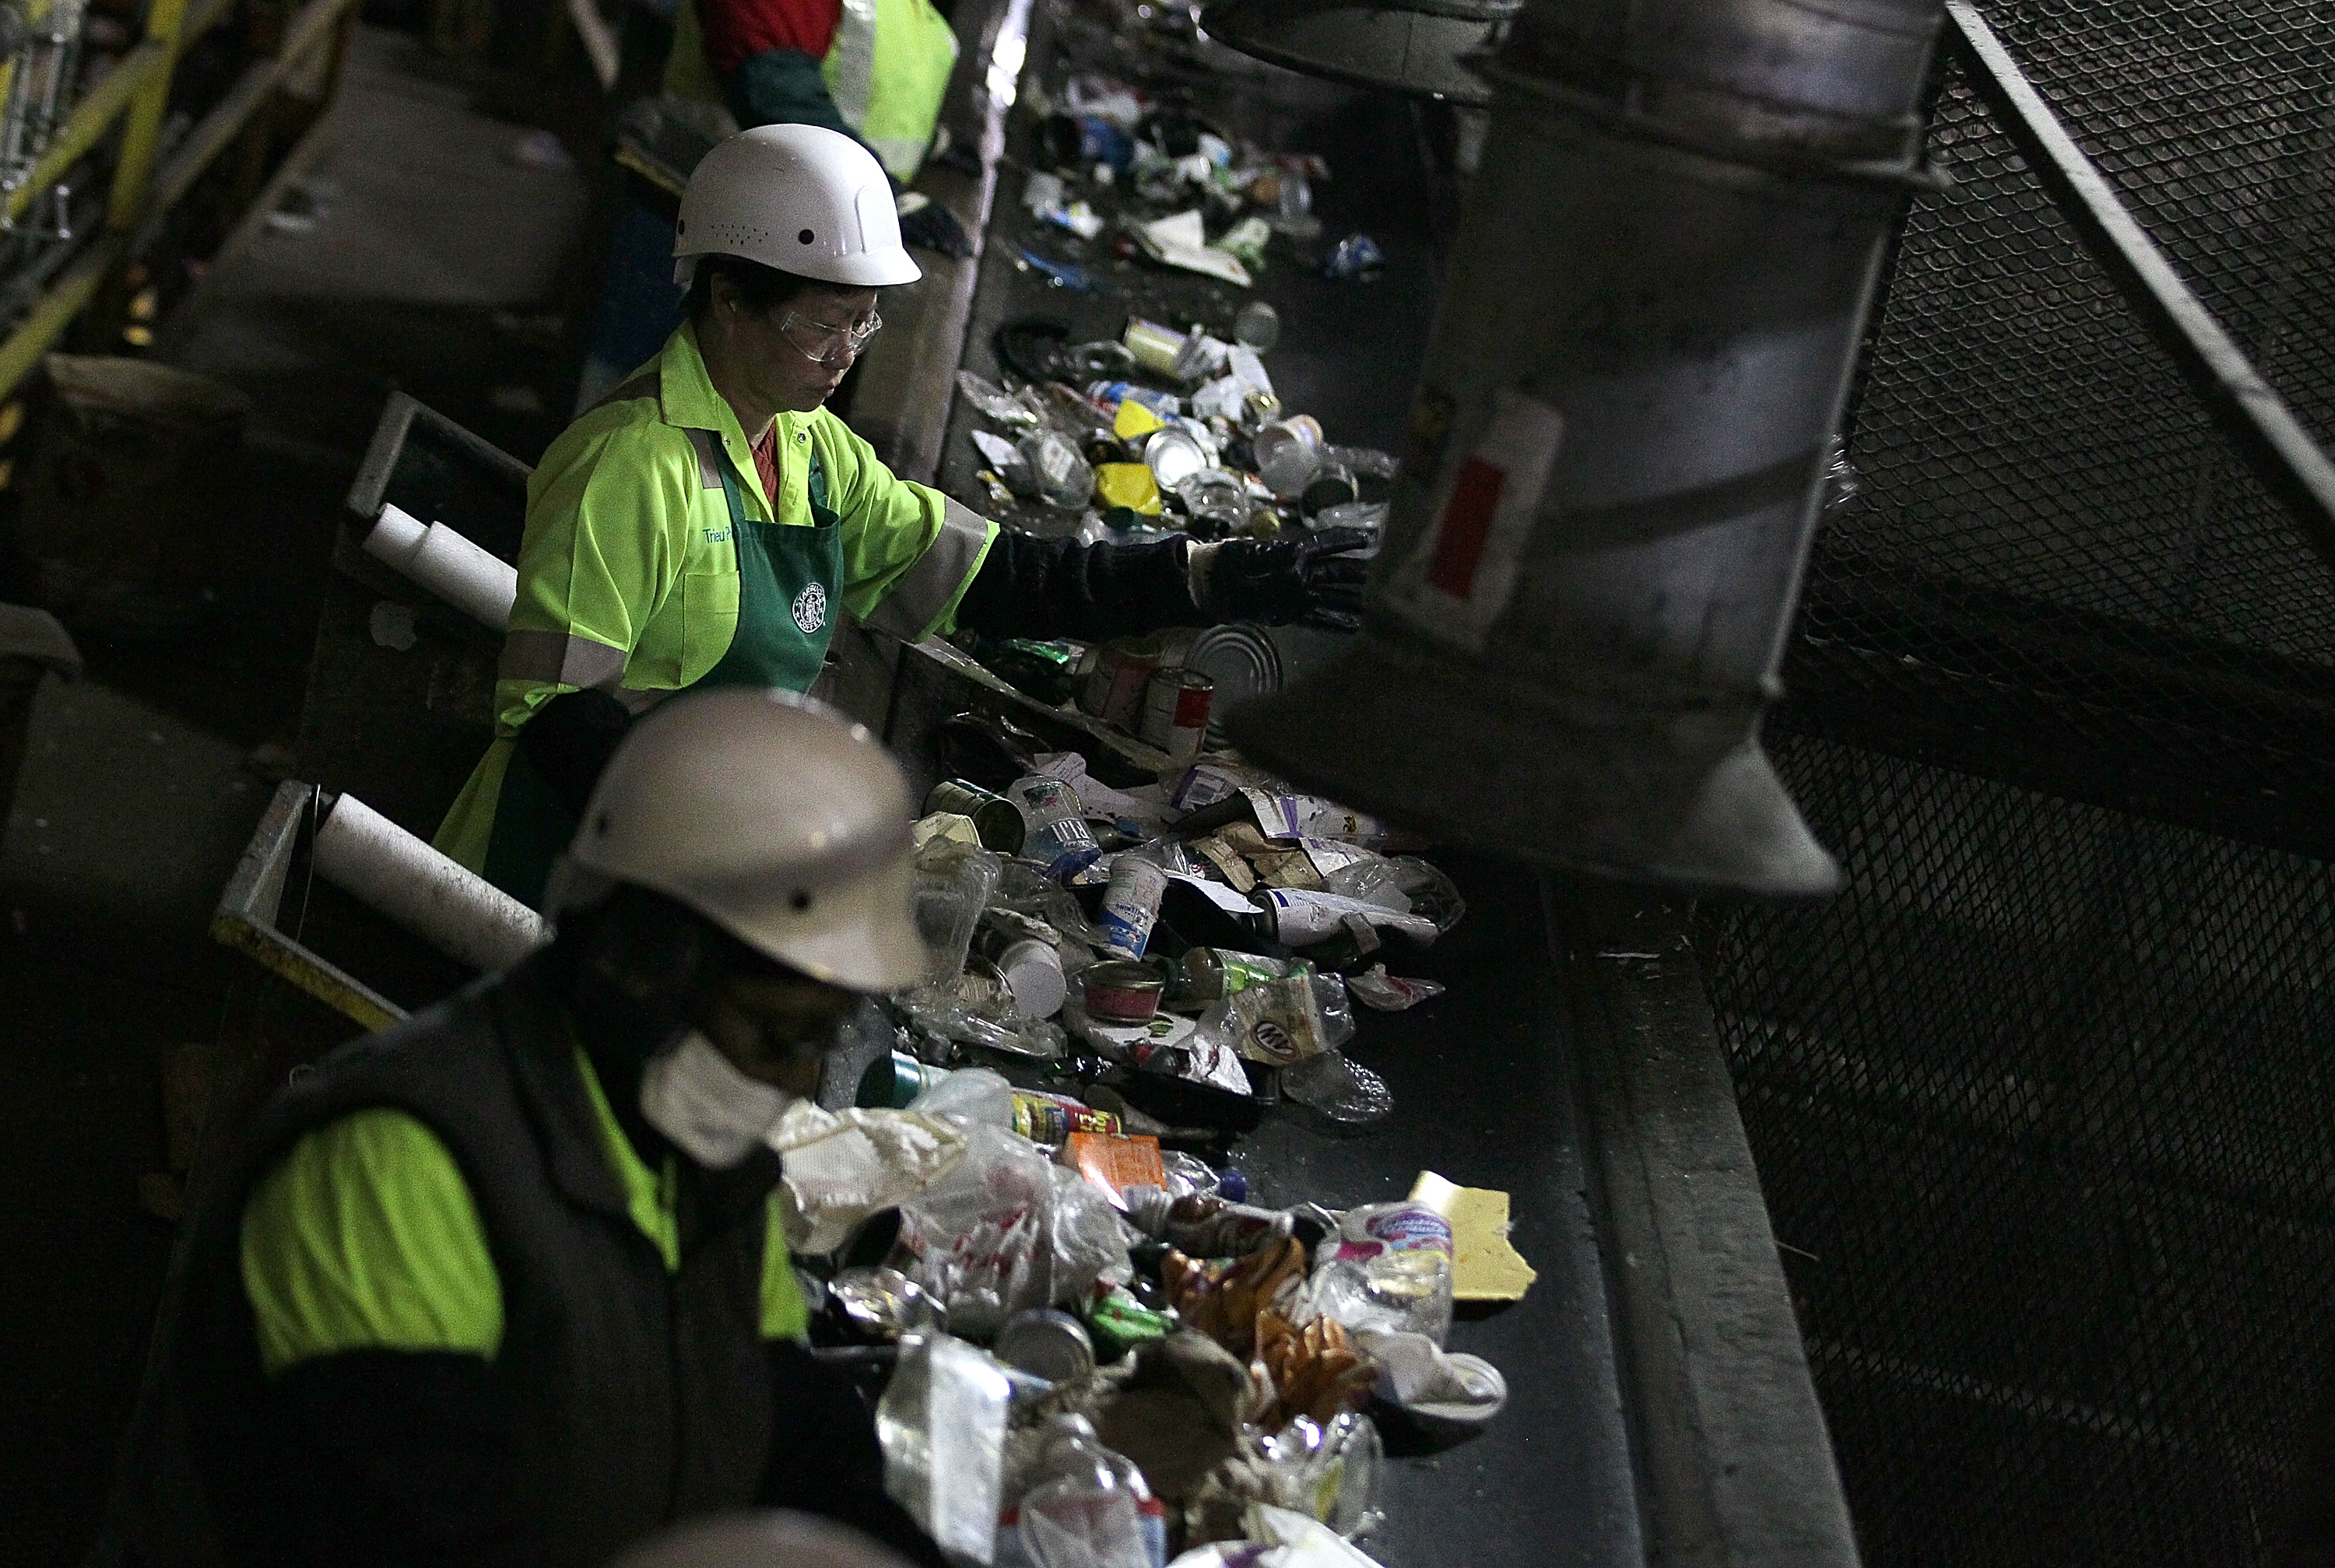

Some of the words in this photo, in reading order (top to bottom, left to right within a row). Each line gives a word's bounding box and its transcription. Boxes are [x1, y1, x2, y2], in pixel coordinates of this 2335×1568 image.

[702, 528, 725, 543] Trieu
[799, 617, 822, 630] COFFEE
[1051, 819, 1090, 843] FIJI
